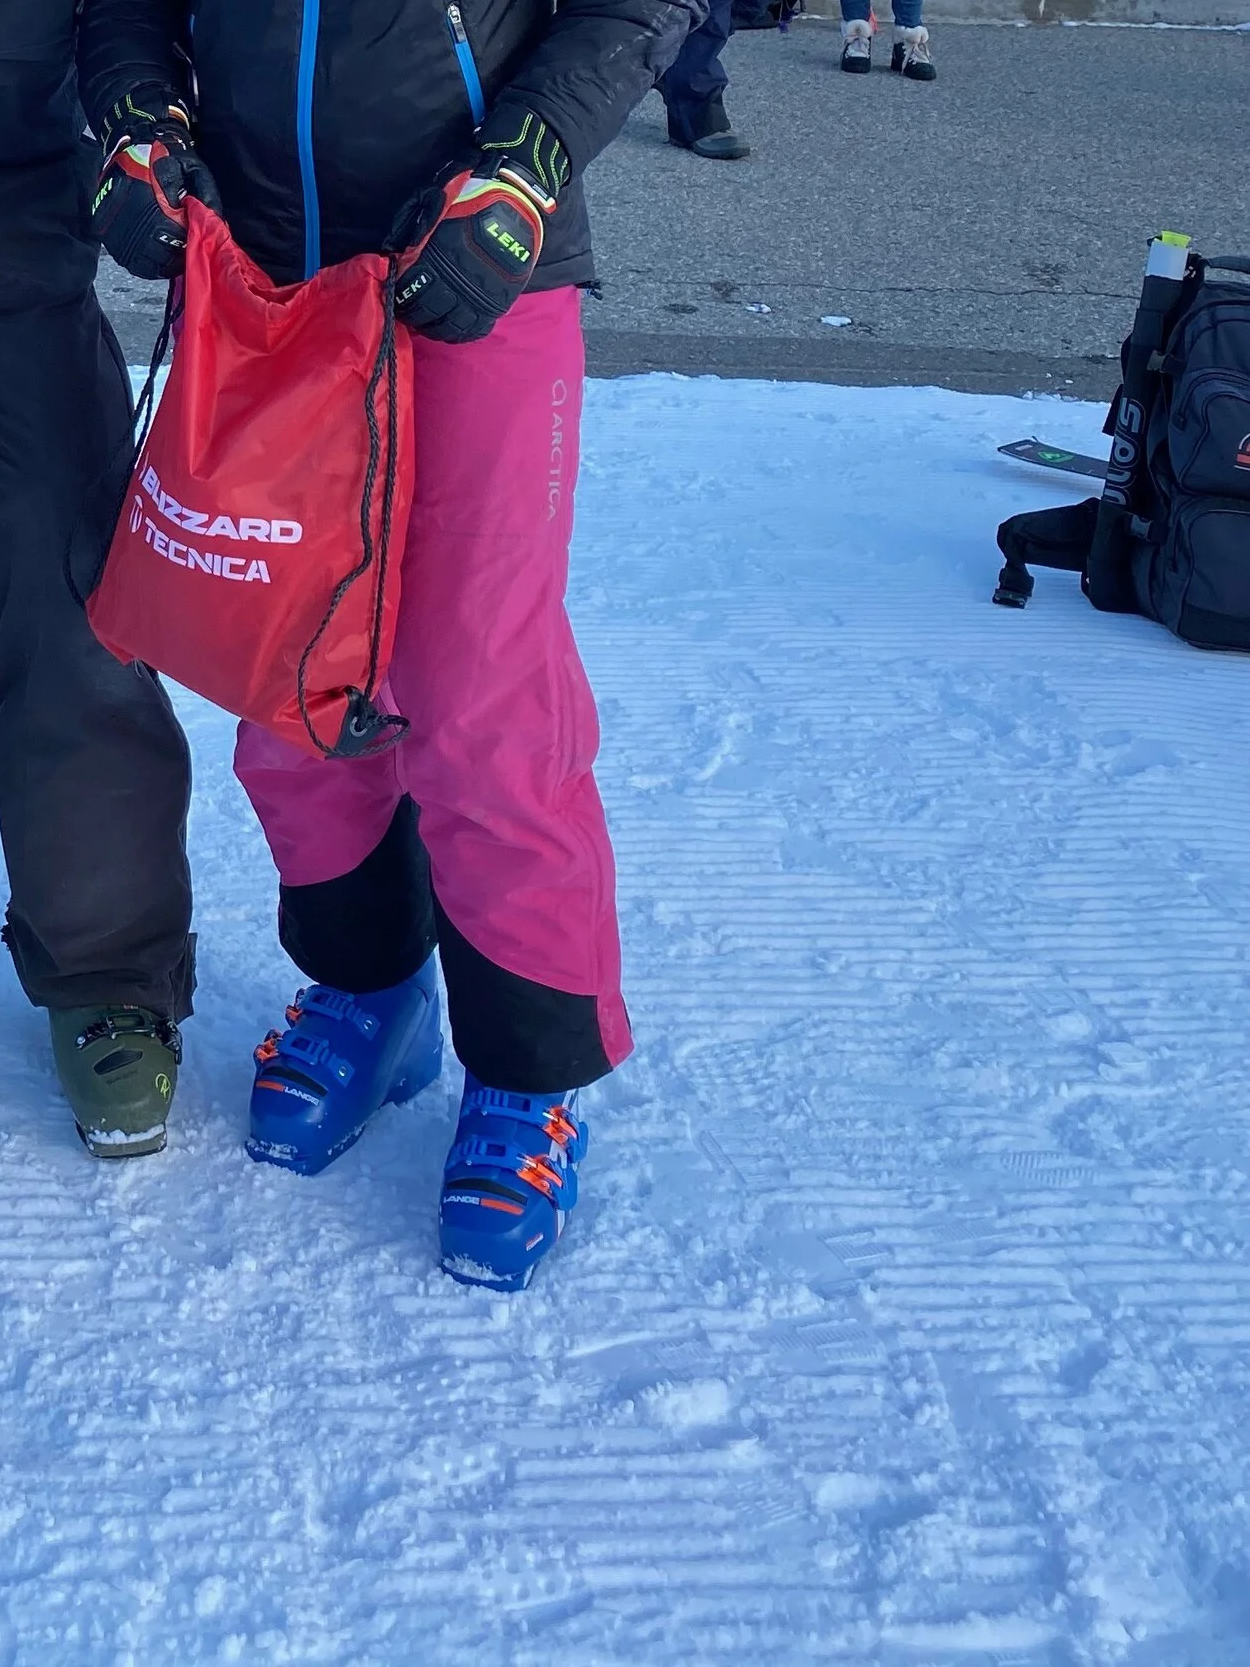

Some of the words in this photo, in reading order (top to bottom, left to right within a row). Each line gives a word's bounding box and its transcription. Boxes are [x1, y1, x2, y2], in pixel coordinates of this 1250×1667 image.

[159, 234, 187, 248] LE
[486, 222, 531, 263] LEKI
[396, 274, 428, 304] LEKI
[547, 412, 563, 522] ARCTICA
[142, 465, 303, 544] BLIZZARD
[144, 516, 271, 583] TECNICA
[284, 1086, 320, 1106] LANGE
